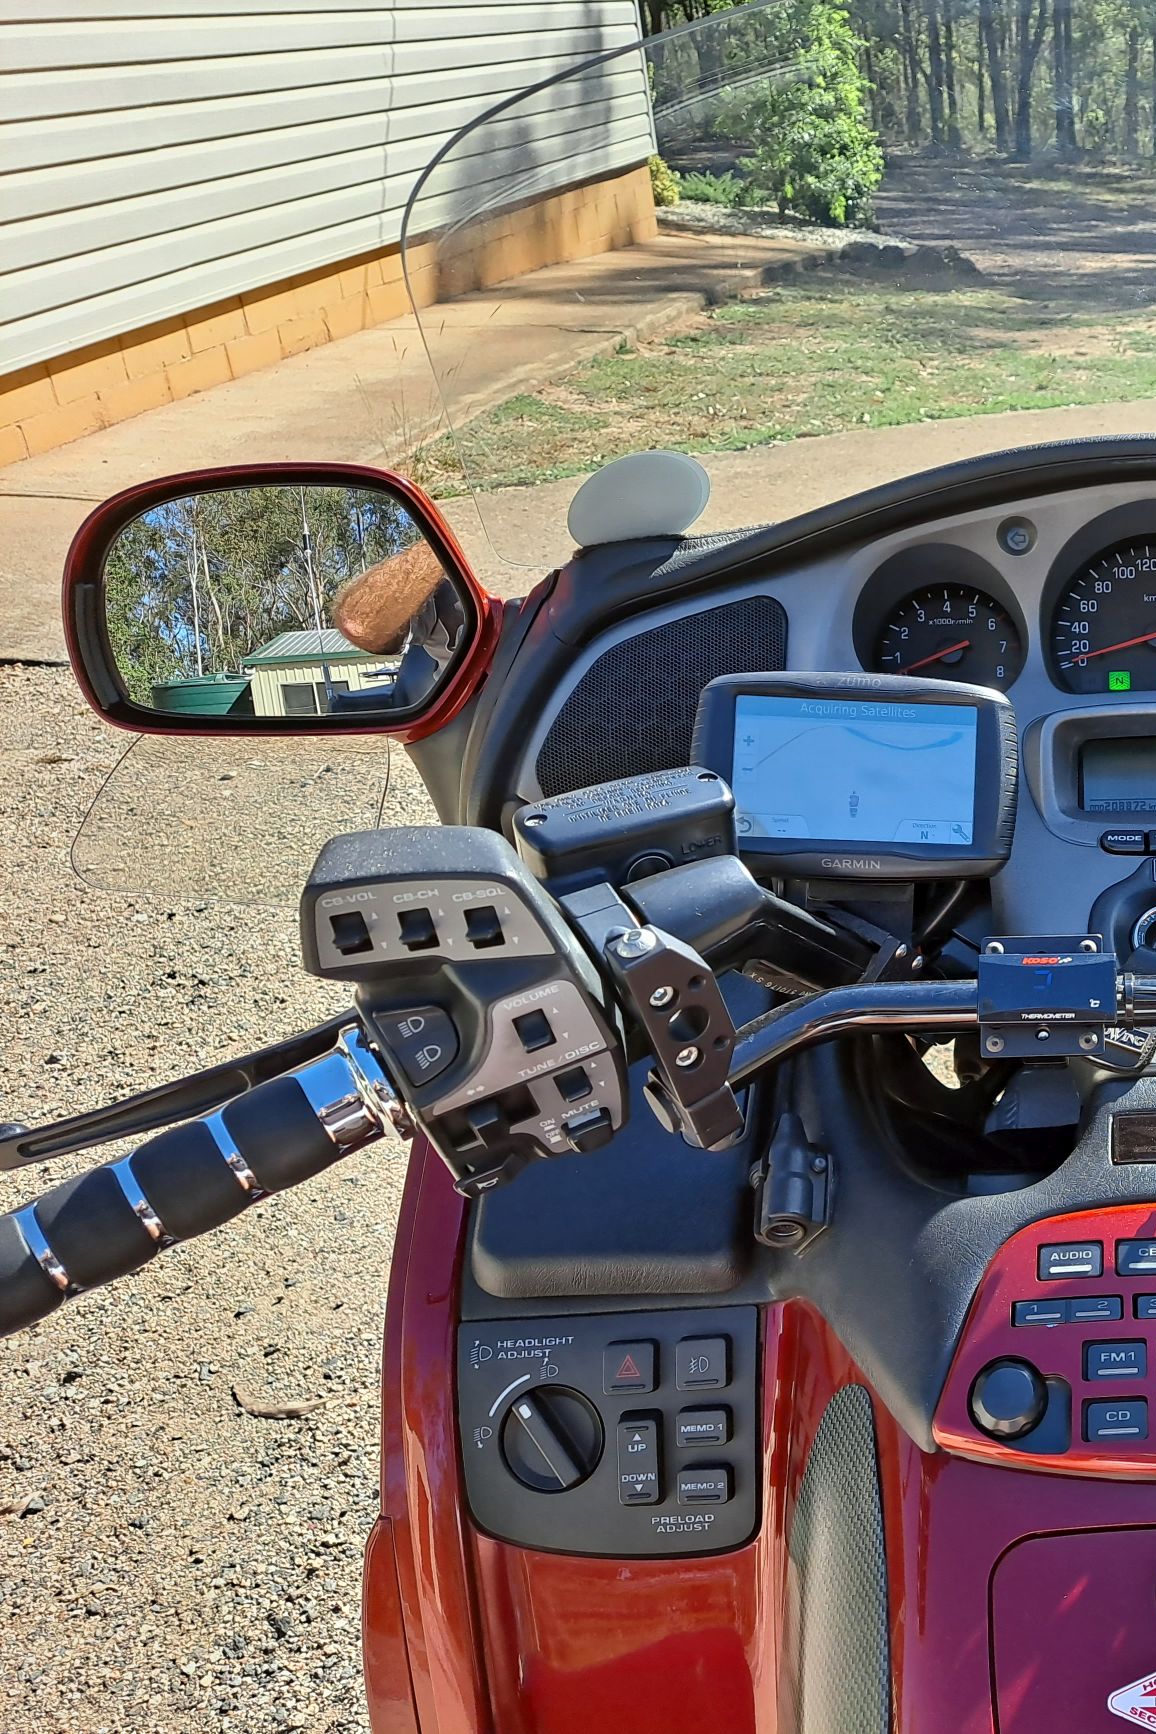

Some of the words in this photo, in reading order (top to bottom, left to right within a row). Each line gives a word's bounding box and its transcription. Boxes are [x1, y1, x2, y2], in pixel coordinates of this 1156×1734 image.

[1112, 567, 1135, 579] 100
[1094, 581, 1112, 593] 80
[943, 601, 951, 613] 4
[968, 605, 977, 617] 5
[1080, 600, 1097, 612] 60
[917, 610, 925, 622] 3
[988, 619, 996, 631] 6
[1071, 622, 1089, 634] 40
[900, 627, 909, 639] 2
[1000, 641, 1007, 653] 7
[1072, 640, 1089, 652] 20
[894, 652, 901, 664] 1
[1078, 655, 1087, 667] 0
[996, 666, 1005, 677] 8
[1115, 677, 1125, 685] N
[800, 703, 857, 718] Acquiring
[861, 705, 917, 719] Satellites
[821, 858, 881, 869] GARMIN
[322, 891, 377, 907] CB-VOL
[393, 888, 439, 904] CB-CH
[452, 887, 506, 902] CB-SQL
[1022, 957, 1058, 965] KOSO
[504, 985, 561, 1011] VOLUME
[518, 1059, 556, 1077] TUNE
[565, 1041, 600, 1060] DISC
[561, 1099, 600, 1119] MUTE
[540, 1118, 555, 1127] ON
[1050, 1251, 1092, 1260] AUDIO
[1030, 1305, 1038, 1313] 1
[1097, 1301, 1108, 1309] 2
[497, 1336, 574, 1349] HEADLIGHT
[497, 1349, 551, 1360] ADJUST
[1100, 1351, 1136, 1364] FM1
[1105, 1410, 1131, 1421] CD
[681, 1423, 715, 1433] MEMO
[717, 1423, 723, 1432] 1
[628, 1443, 647, 1453] UP
[621, 1472, 656, 1482] DOWN
[681, 1482, 715, 1491] MEMO
[717, 1482, 725, 1490] 2
[651, 1514, 715, 1525] PRELOAD
[656, 1522, 711, 1533] ADJUST
